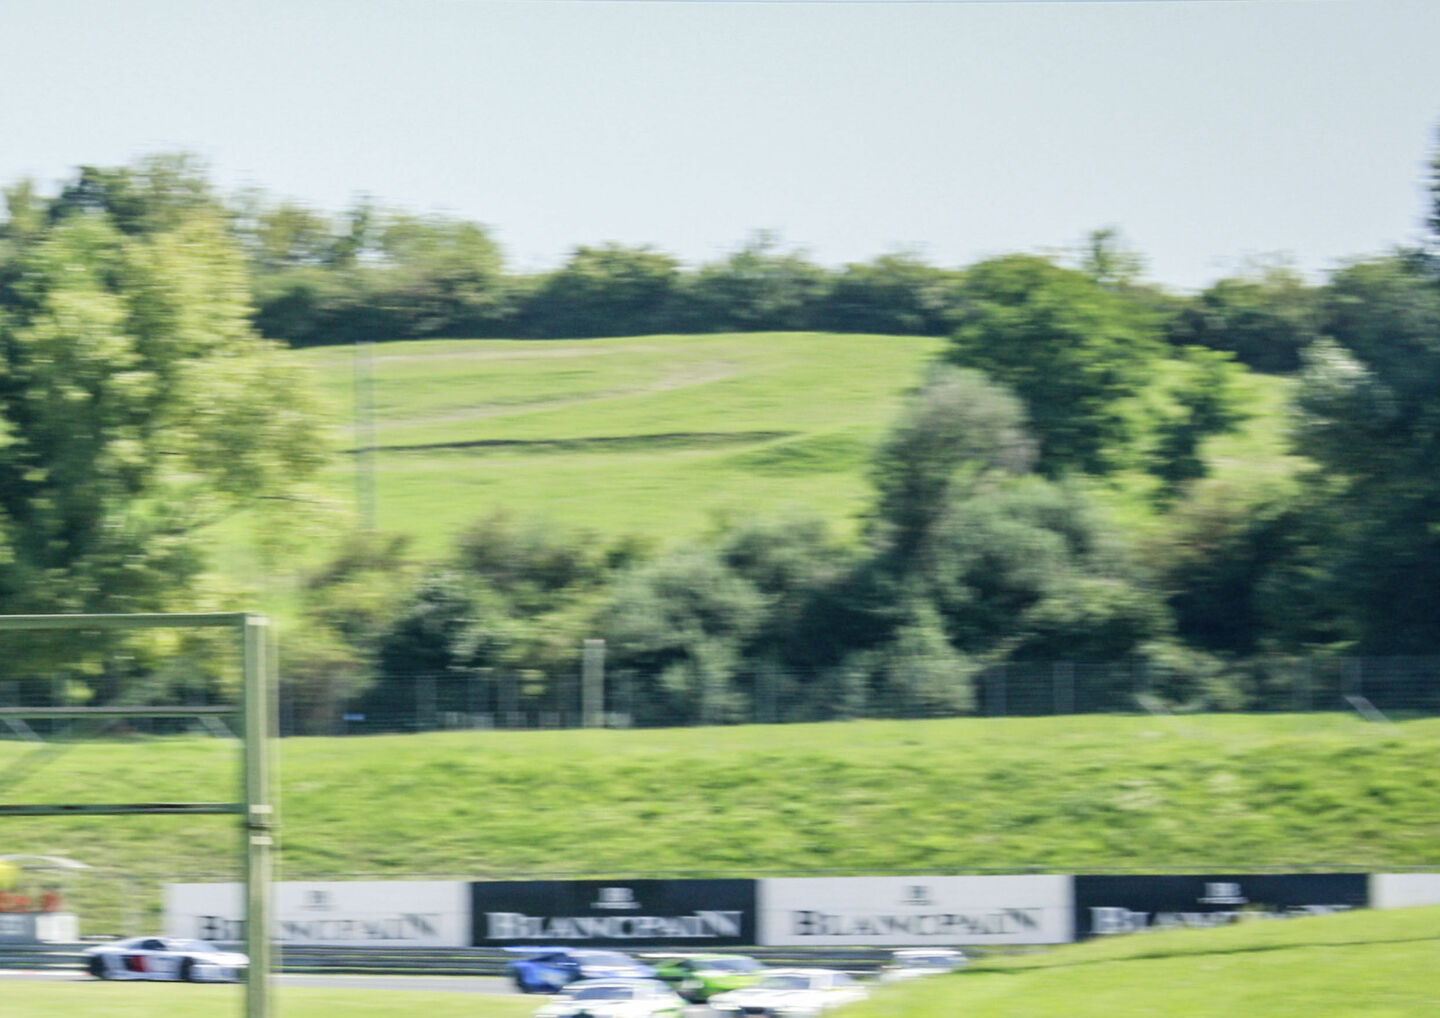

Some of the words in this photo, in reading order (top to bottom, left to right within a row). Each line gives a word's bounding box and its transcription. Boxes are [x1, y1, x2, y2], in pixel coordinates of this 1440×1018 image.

[196, 914, 441, 941] BLNCPAIN
[485, 911, 744, 940] BLANCPAIN
[791, 907, 1042, 936] BLANCPAIN
